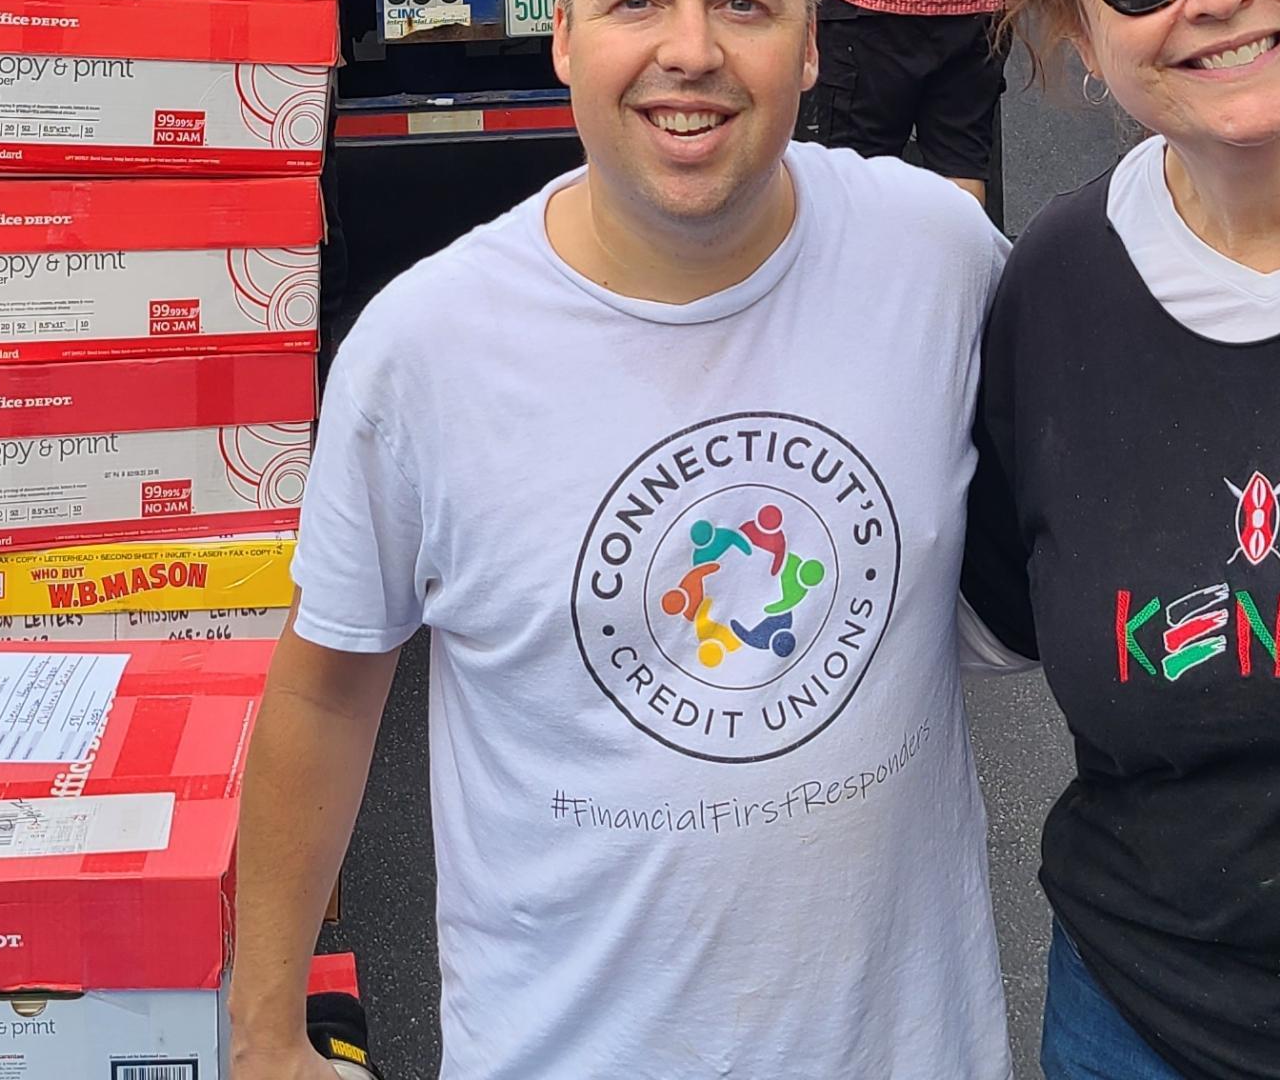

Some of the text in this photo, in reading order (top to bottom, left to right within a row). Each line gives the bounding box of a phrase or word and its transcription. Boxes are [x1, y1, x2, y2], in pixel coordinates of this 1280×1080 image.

[387, 8, 426, 19] CIMC
[53, 58, 68, 76] &
[73, 58, 134, 82] print
[156, 131, 200, 142] NO JAM
[46, 253, 60, 271] &
[66, 250, 125, 277] print
[17, 322, 27, 330] 92
[152, 320, 197, 332] NO JAM
[39, 439, 53, 457] &
[58, 433, 119, 462] print
[144, 501, 188, 513] NO JAM
[591, 429, 882, 600] CONNECTICUT'S
[44, 553, 94, 562] LETTERHEAD
[100, 552, 132, 560] SECOND
[134, 551, 159, 559] SHEET
[165, 551, 191, 559] INKJET
[31, 567, 85, 581] WHO BUT
[48, 561, 208, 609] W.B.MASON
[610, 596, 873, 738] CREDIT UNIONS
[551, 718, 930, 834] #FinancialFirstResponders
[11, 1018, 56, 1038] print
